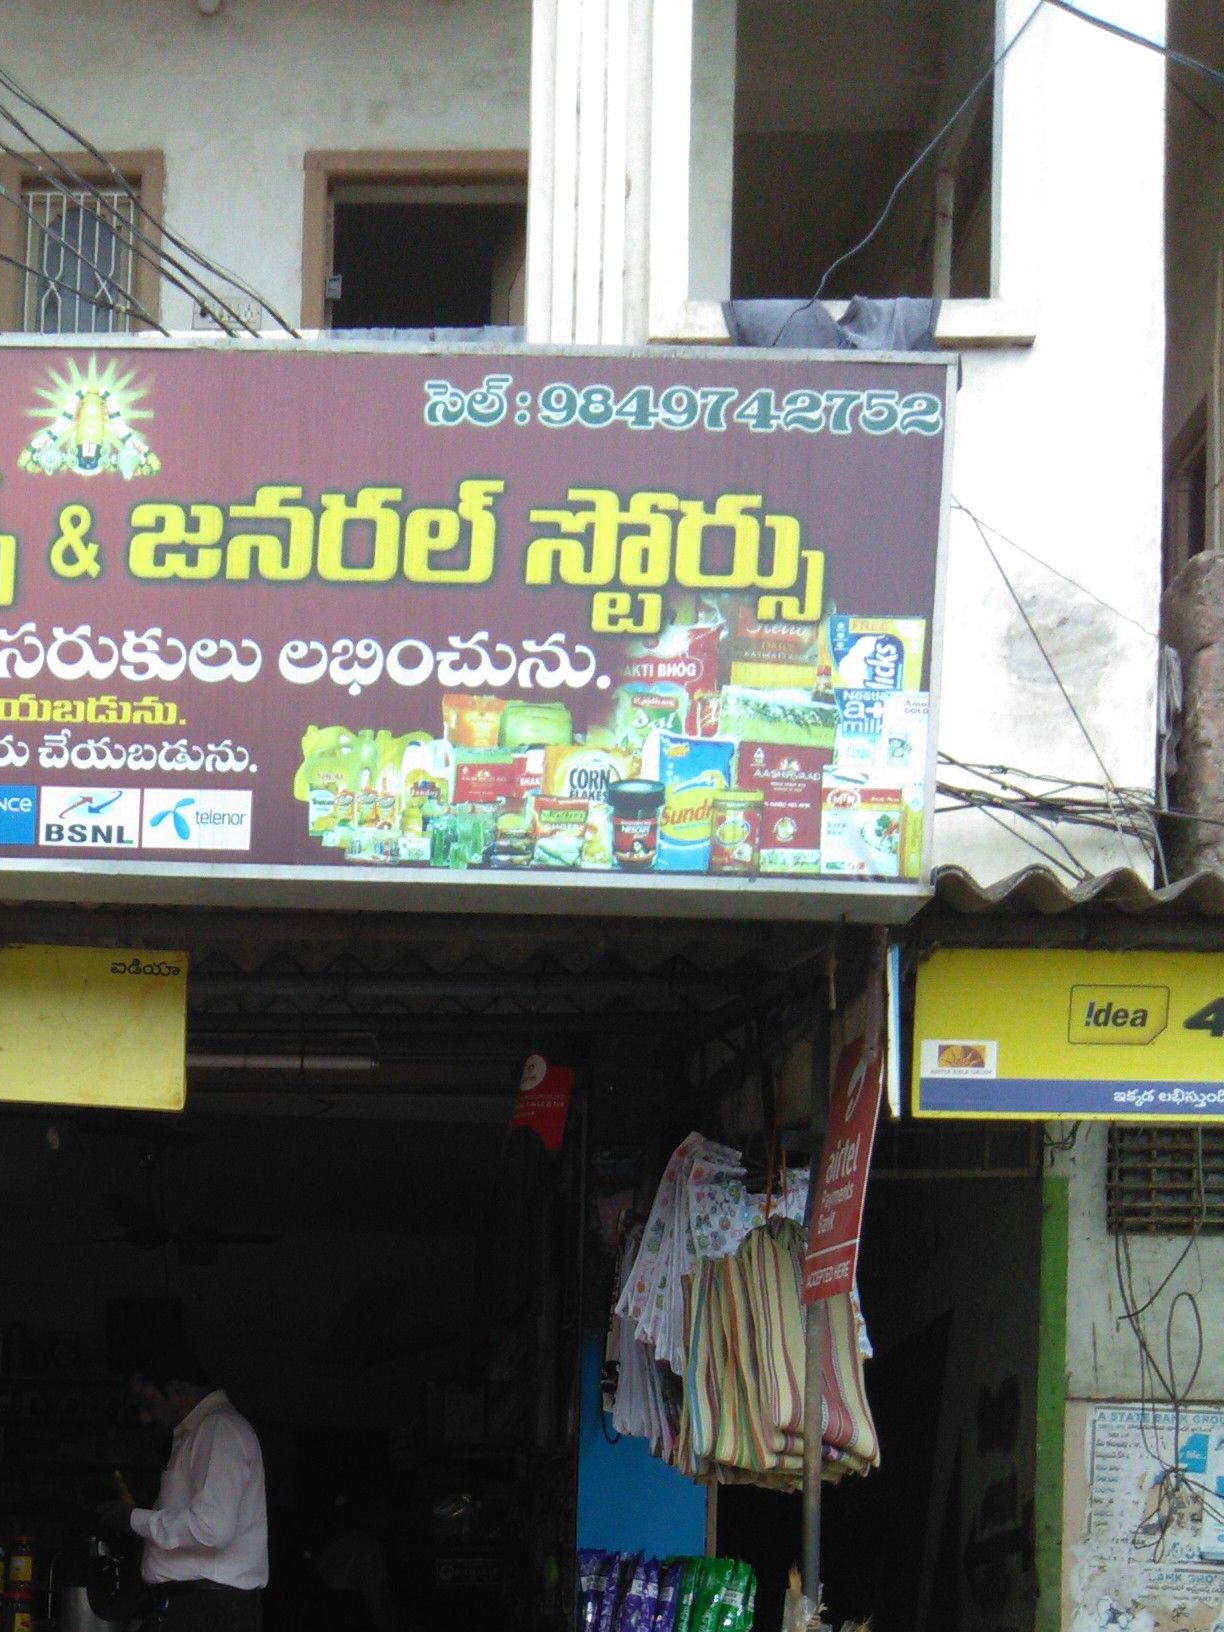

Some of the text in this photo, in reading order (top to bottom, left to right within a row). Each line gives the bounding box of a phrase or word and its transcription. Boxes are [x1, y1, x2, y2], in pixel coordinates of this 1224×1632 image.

[50, 504, 102, 578] &
[129, 480, 505, 584] జనరల్
[623, 662, 698, 678] AKTI BHOG
[569, 768, 610, 790] CORN
[195, 808, 247, 827] telenor
[44, 823, 134, 845] BSNL
[825, 1133, 861, 1184] airtel
